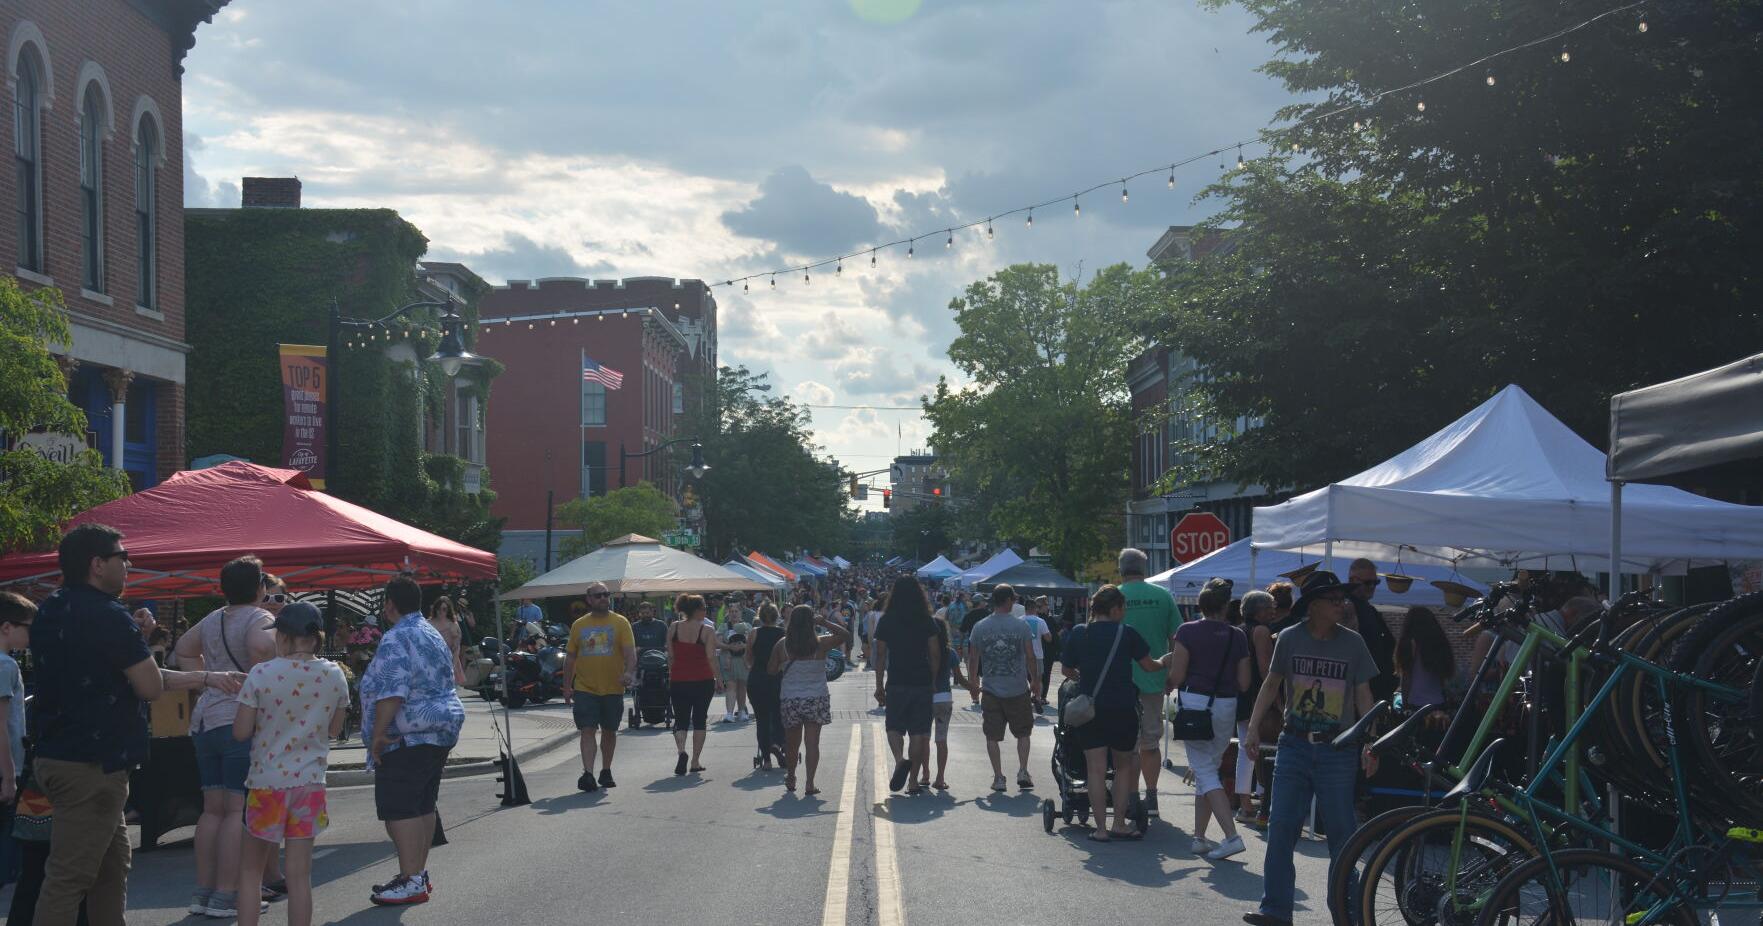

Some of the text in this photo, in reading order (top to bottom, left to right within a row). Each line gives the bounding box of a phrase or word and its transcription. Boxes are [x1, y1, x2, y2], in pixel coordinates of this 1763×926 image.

[288, 365, 310, 388] TOP
[1176, 531, 1226, 555] STOP
[1294, 657, 1346, 679] TOM PETTY
